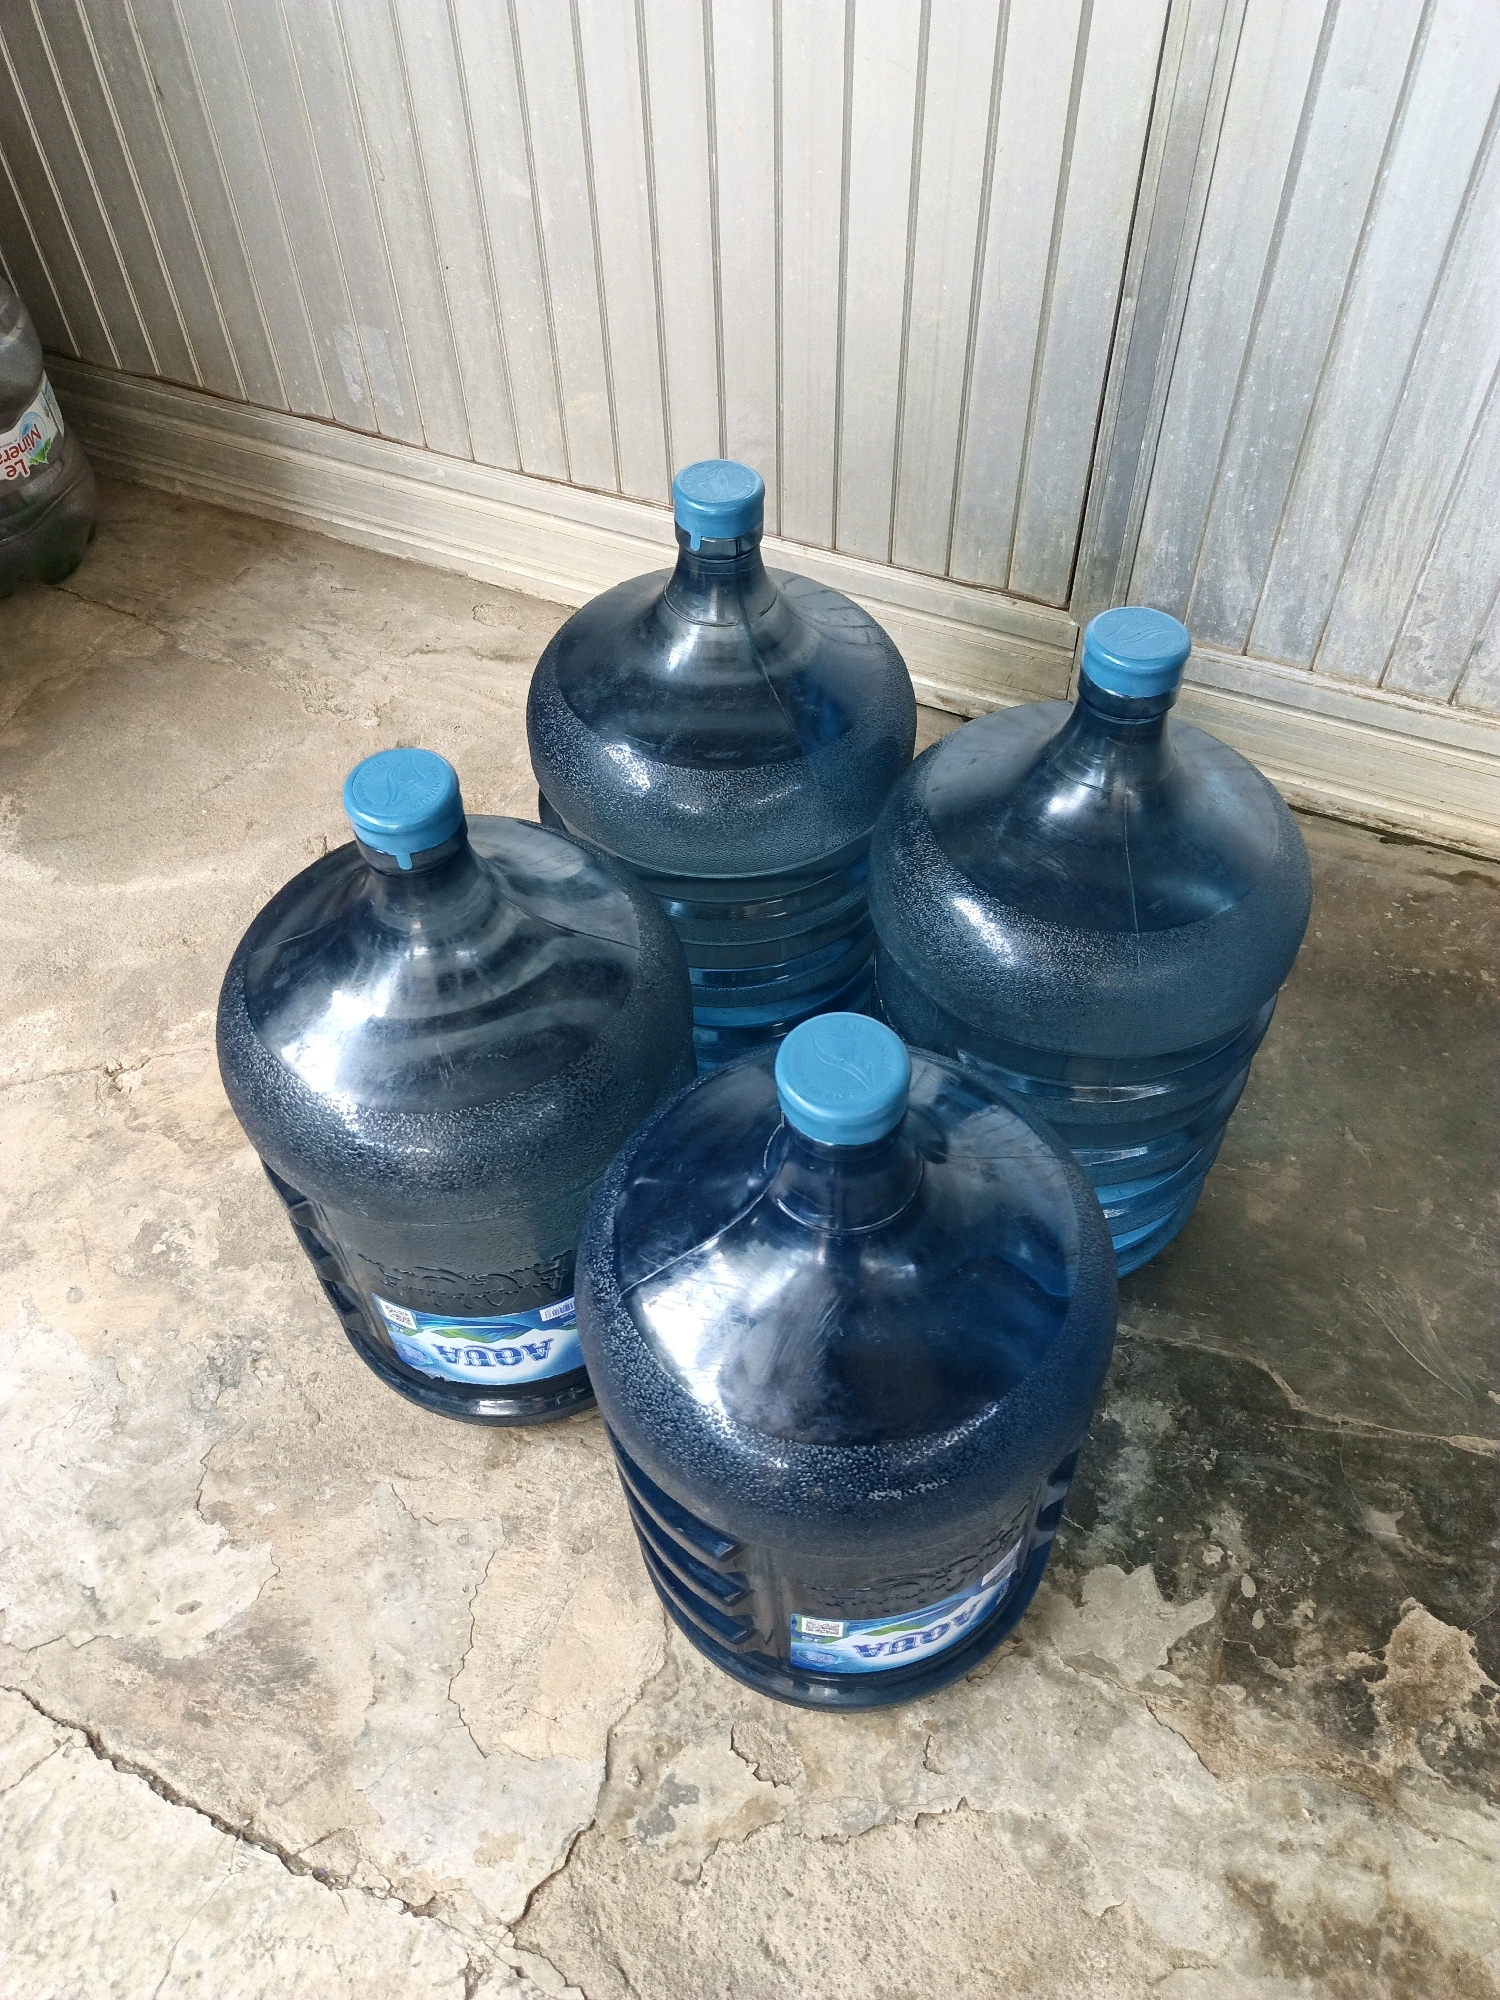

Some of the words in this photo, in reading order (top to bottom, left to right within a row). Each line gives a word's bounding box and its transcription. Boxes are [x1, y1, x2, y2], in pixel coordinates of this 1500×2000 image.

[0, 424, 42, 465] Miner
[5, 458, 29, 478] Le
[431, 1338, 555, 1367] AQUA
[850, 1597, 983, 1658] AQUA
